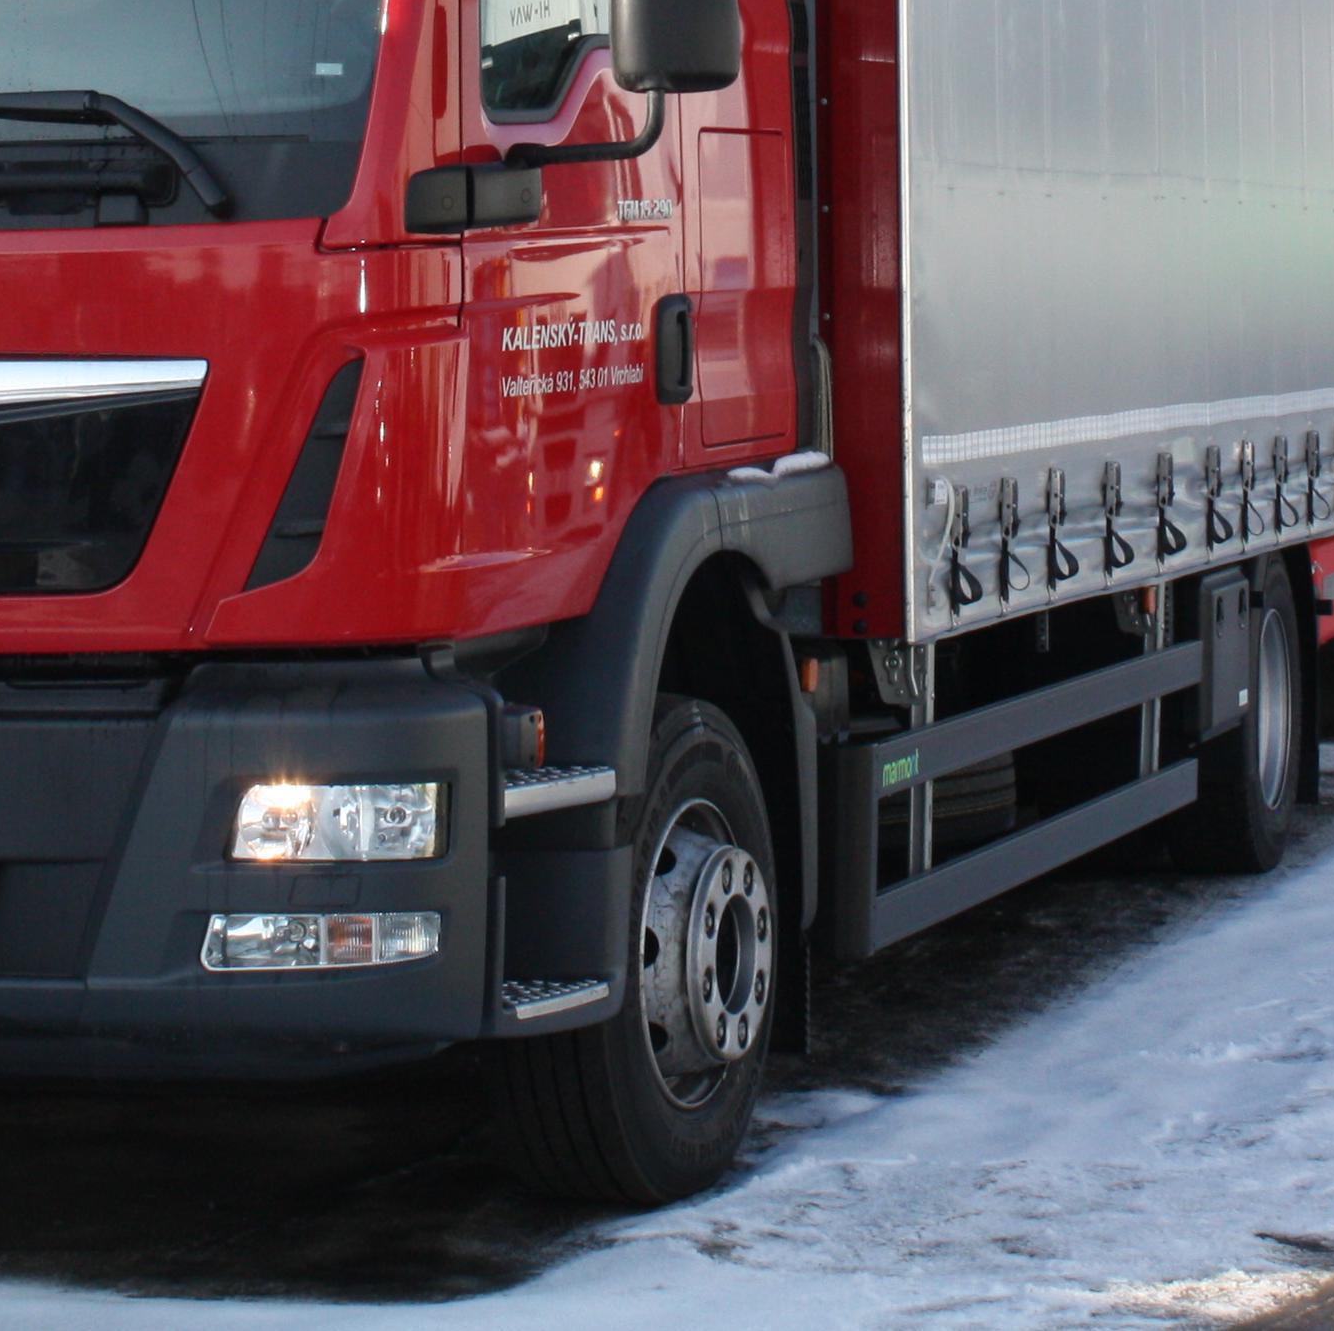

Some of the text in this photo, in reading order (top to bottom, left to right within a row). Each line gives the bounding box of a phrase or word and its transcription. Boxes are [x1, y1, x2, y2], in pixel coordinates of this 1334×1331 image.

[501, 316, 618, 352] KALENSKÝ-TRANS,
[579, 368, 596, 390] 543
[597, 367, 609, 387] 01
